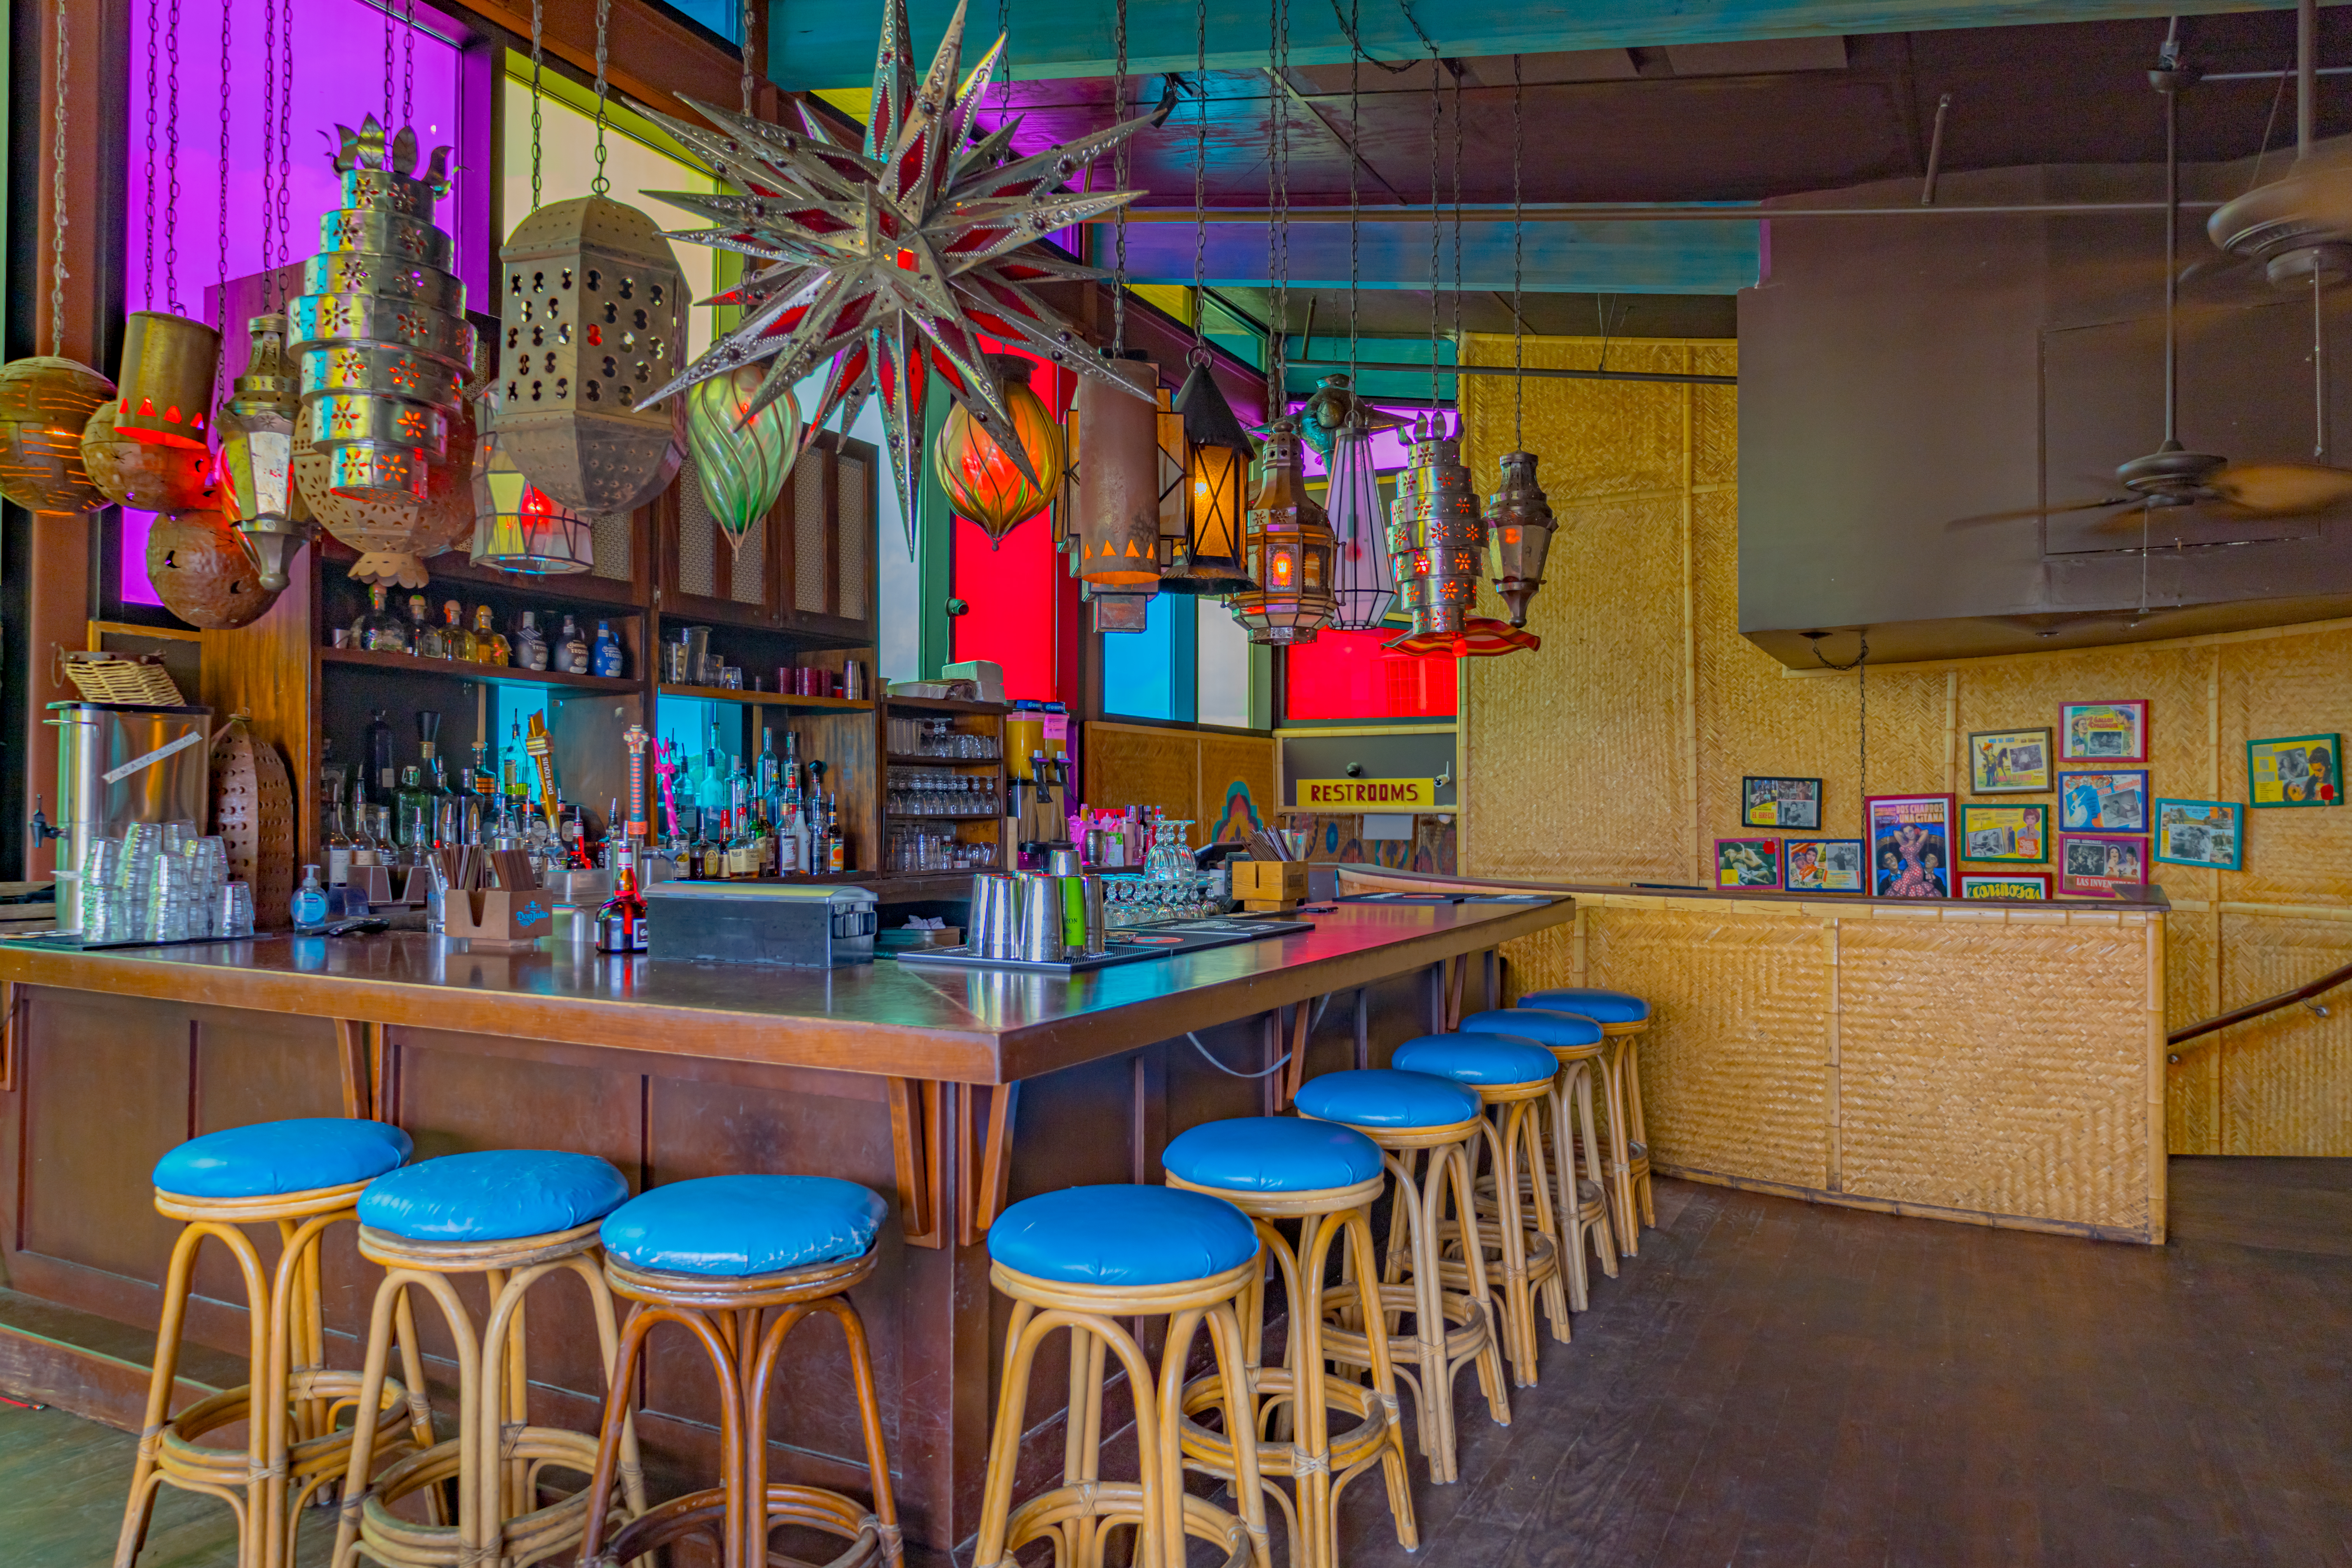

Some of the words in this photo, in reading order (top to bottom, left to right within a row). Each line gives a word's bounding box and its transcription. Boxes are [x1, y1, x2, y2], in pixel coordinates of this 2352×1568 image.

[542, 757, 551, 778] EQUIS
[546, 780, 554, 795] DOS
[1311, 784, 1418, 801] RESTROOMS
[1896, 805, 1909, 814] DOS
[1910, 803, 1943, 813] CHARROS
[1899, 814, 1915, 823] UNA
[2076, 877, 2089, 886] LAS
